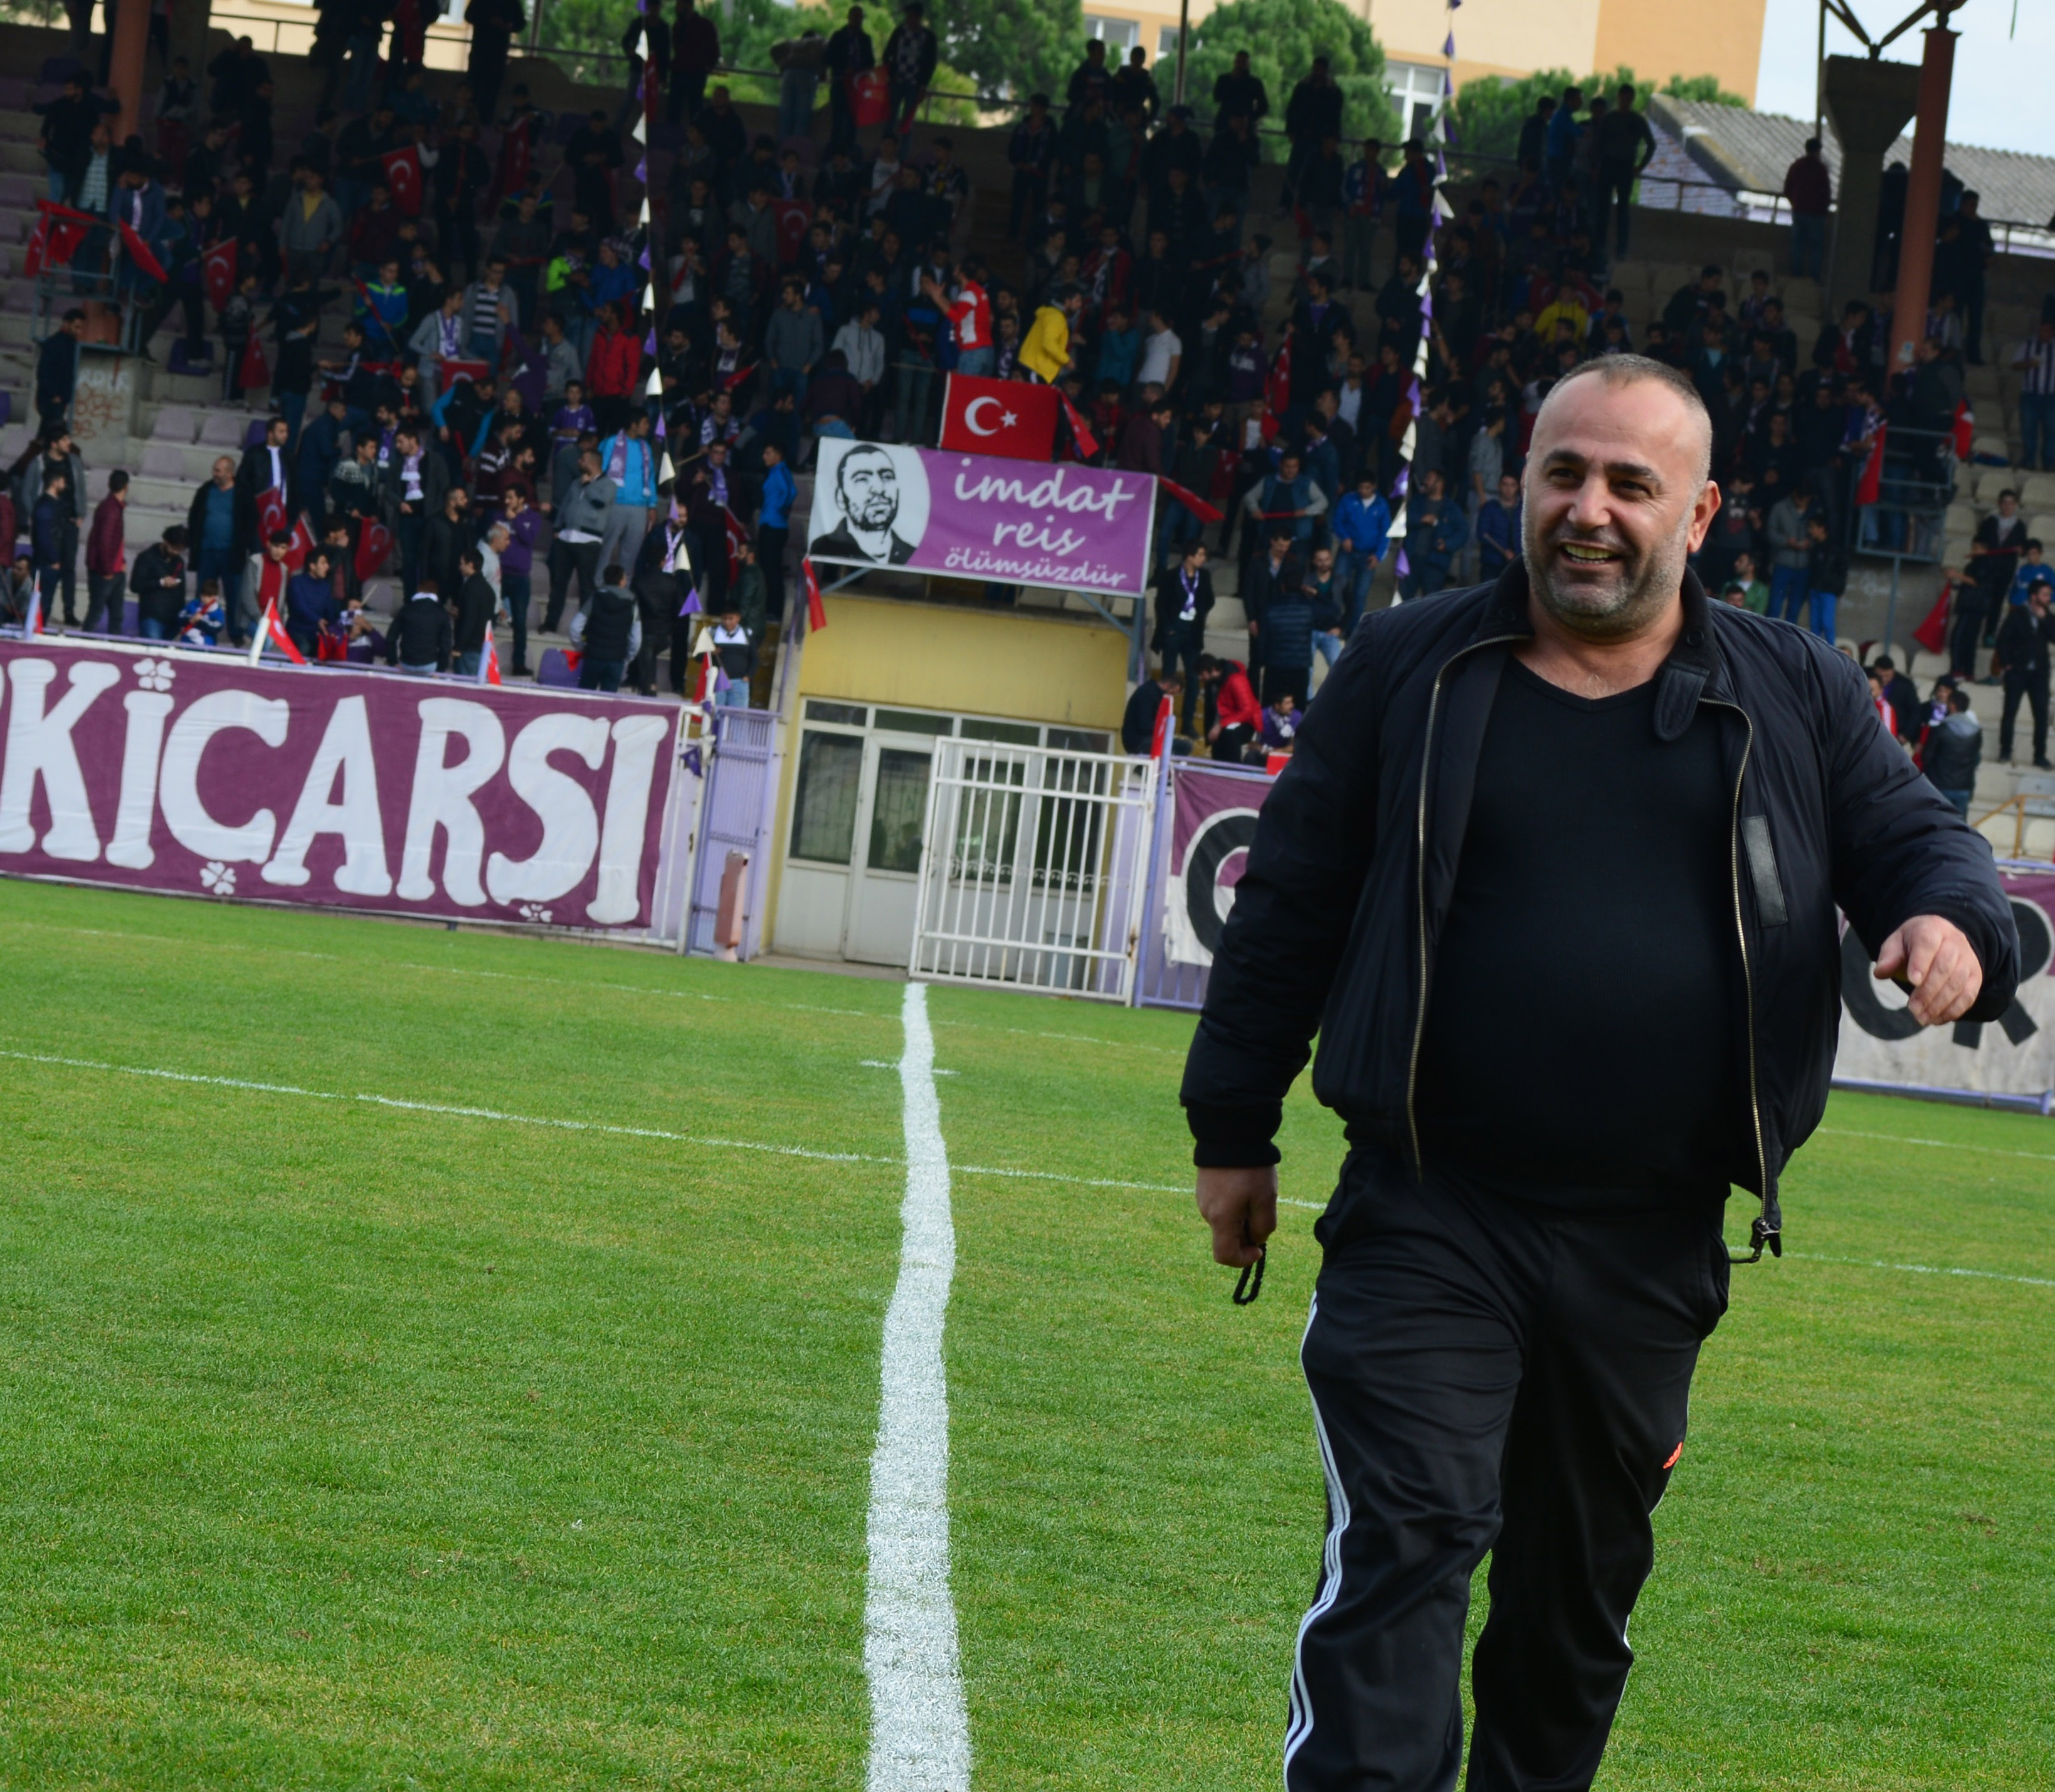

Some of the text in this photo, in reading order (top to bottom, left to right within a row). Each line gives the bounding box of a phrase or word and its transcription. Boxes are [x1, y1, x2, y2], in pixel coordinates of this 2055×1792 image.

[954, 457, 1136, 522] imdat
[993, 514, 1087, 557] reis
[944, 547, 1128, 588] ölümsüzdür
